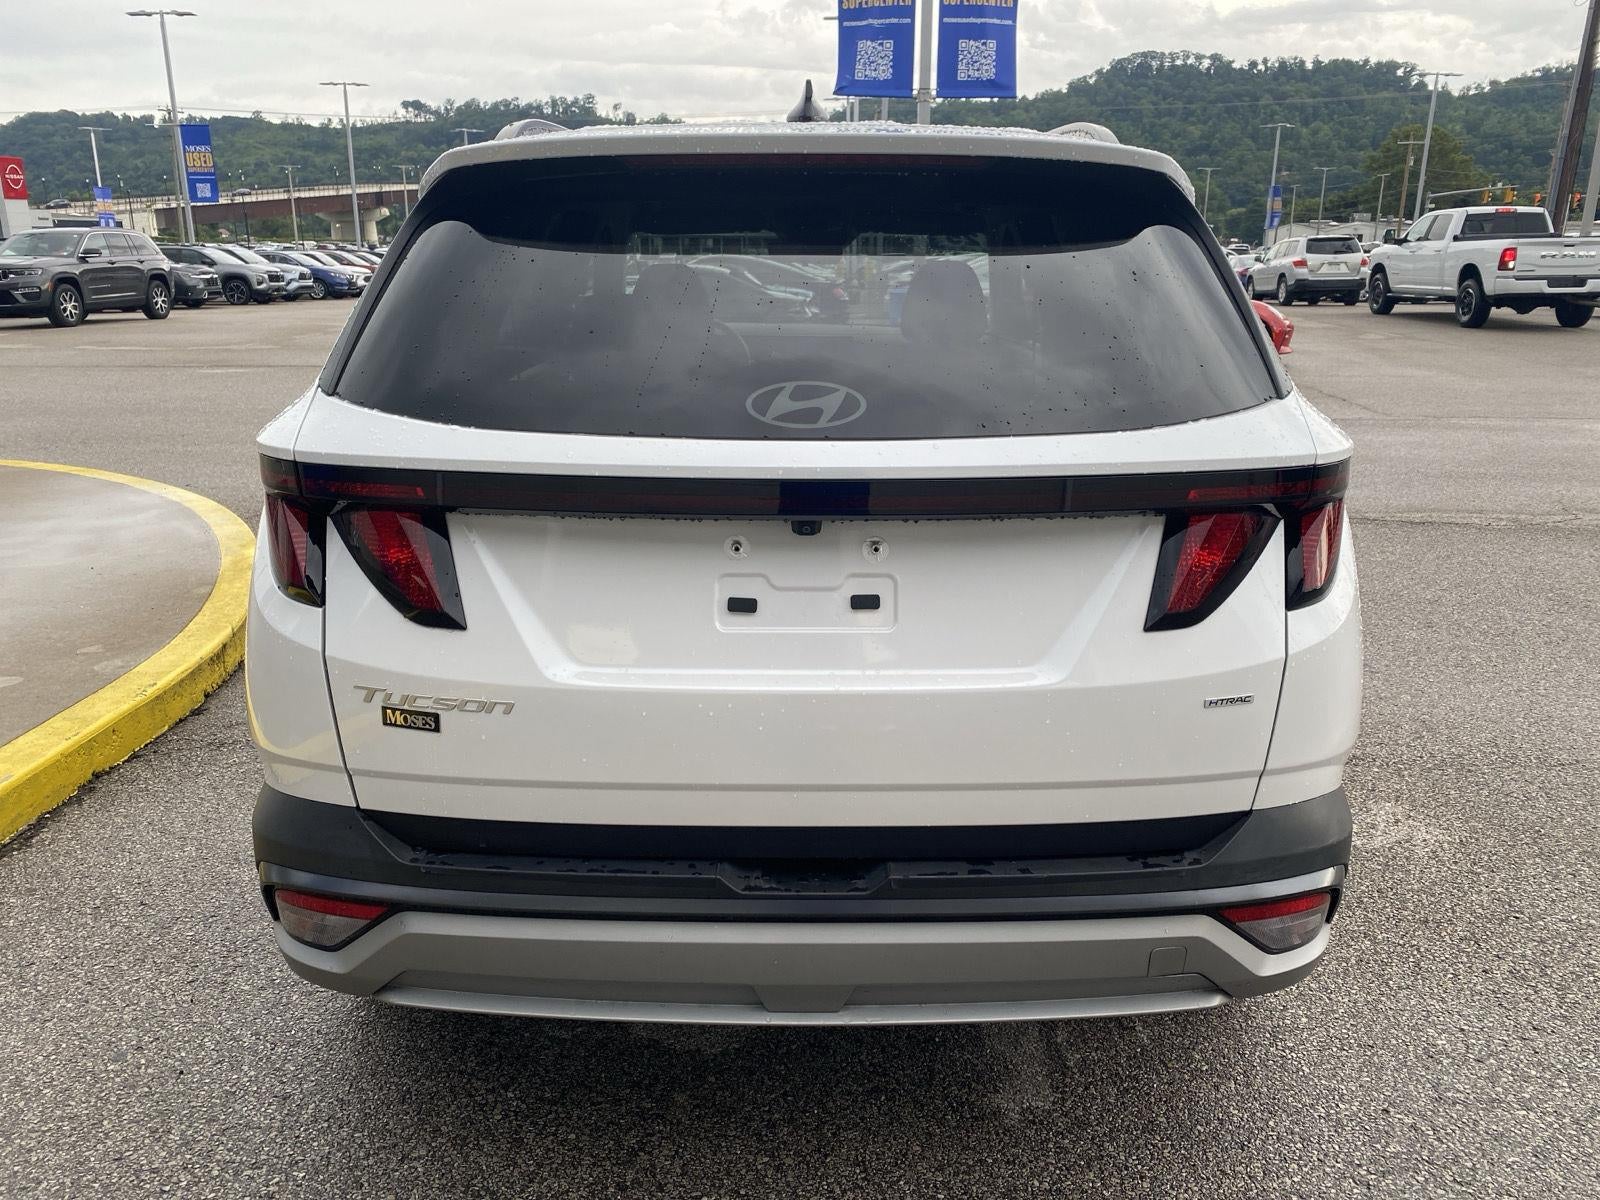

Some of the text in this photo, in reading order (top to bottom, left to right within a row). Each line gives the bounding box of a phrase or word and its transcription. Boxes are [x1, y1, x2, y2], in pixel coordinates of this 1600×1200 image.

[843, 18, 911, 26] supercenter.com
[186, 152, 213, 167] USED
[1541, 251, 1597, 259] RAM
[1208, 695, 1252, 706] HTRAC
